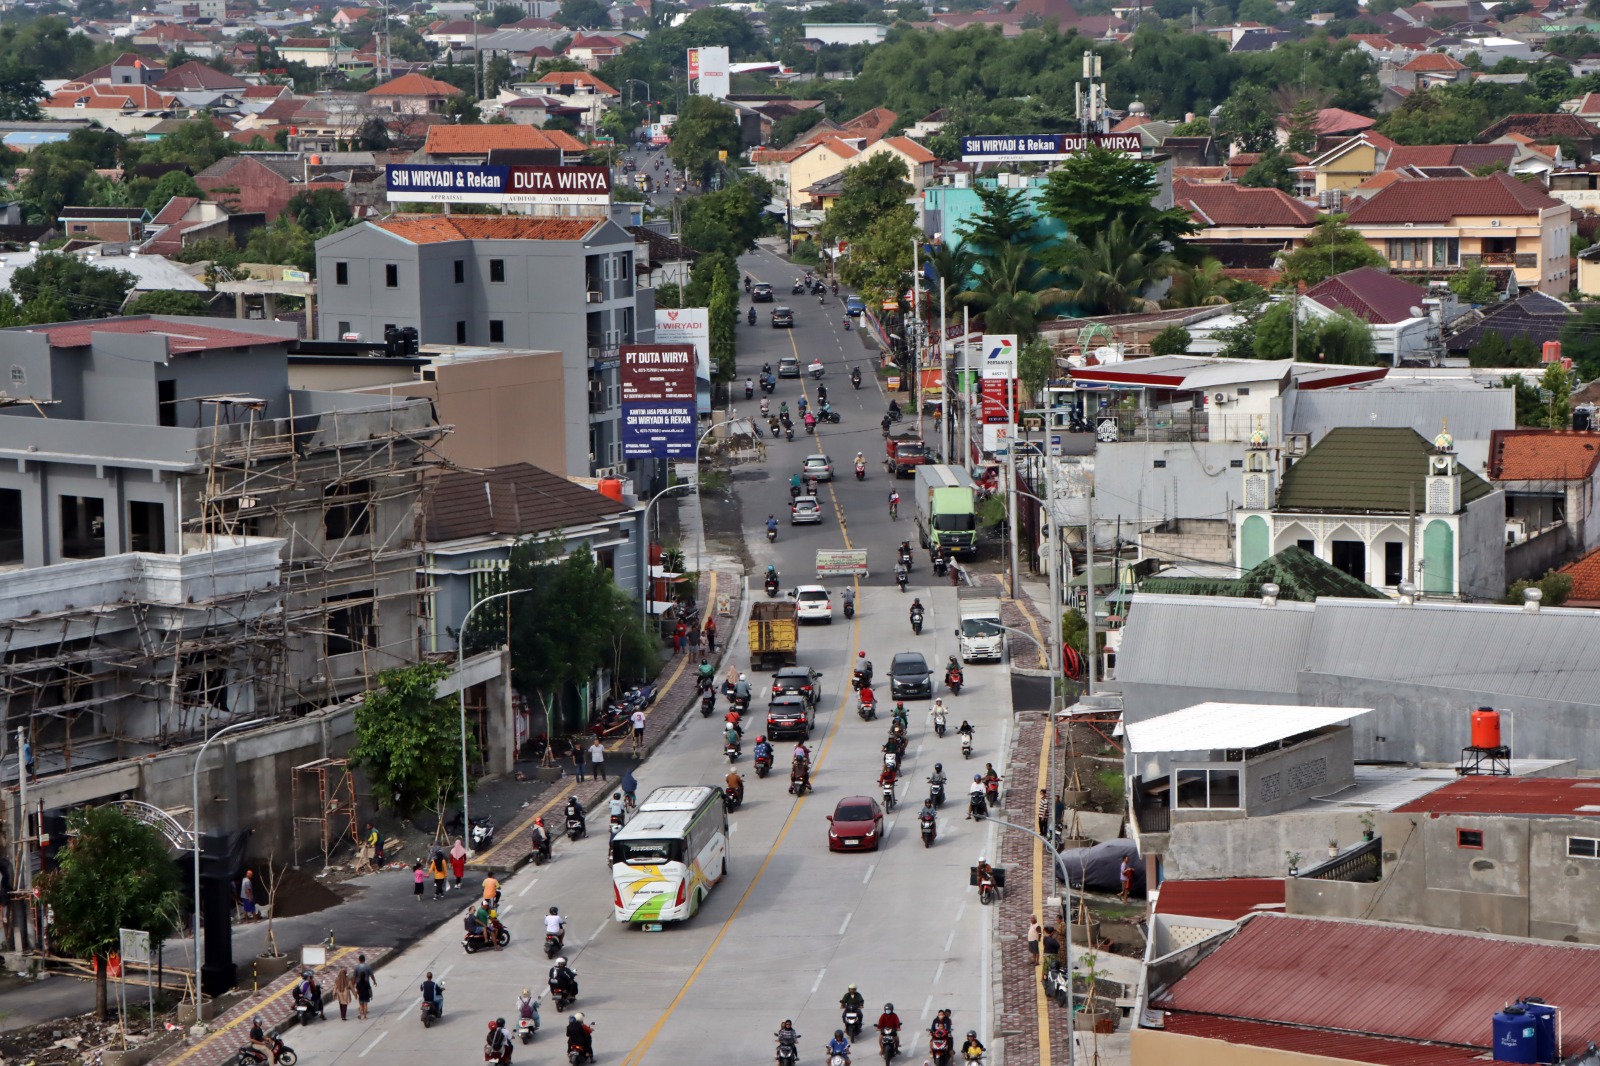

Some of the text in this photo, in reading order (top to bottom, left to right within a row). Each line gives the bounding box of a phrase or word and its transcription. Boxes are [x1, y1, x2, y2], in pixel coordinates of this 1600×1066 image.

[966, 138, 1055, 152] SIH WIRYADI & Rekan
[1100, 136, 1140, 150] WIRYA
[391, 170, 500, 188] SIH WIRYADI & Rekan
[514, 172, 607, 189] DUTA WIRYA
[662, 322, 702, 330] WIRYADI
[626, 352, 637, 364] PT
[639, 352, 660, 364] DUTA
[661, 351, 689, 364] WIRYA
[626, 416, 691, 425] SIH WIRYADI & REKAN
